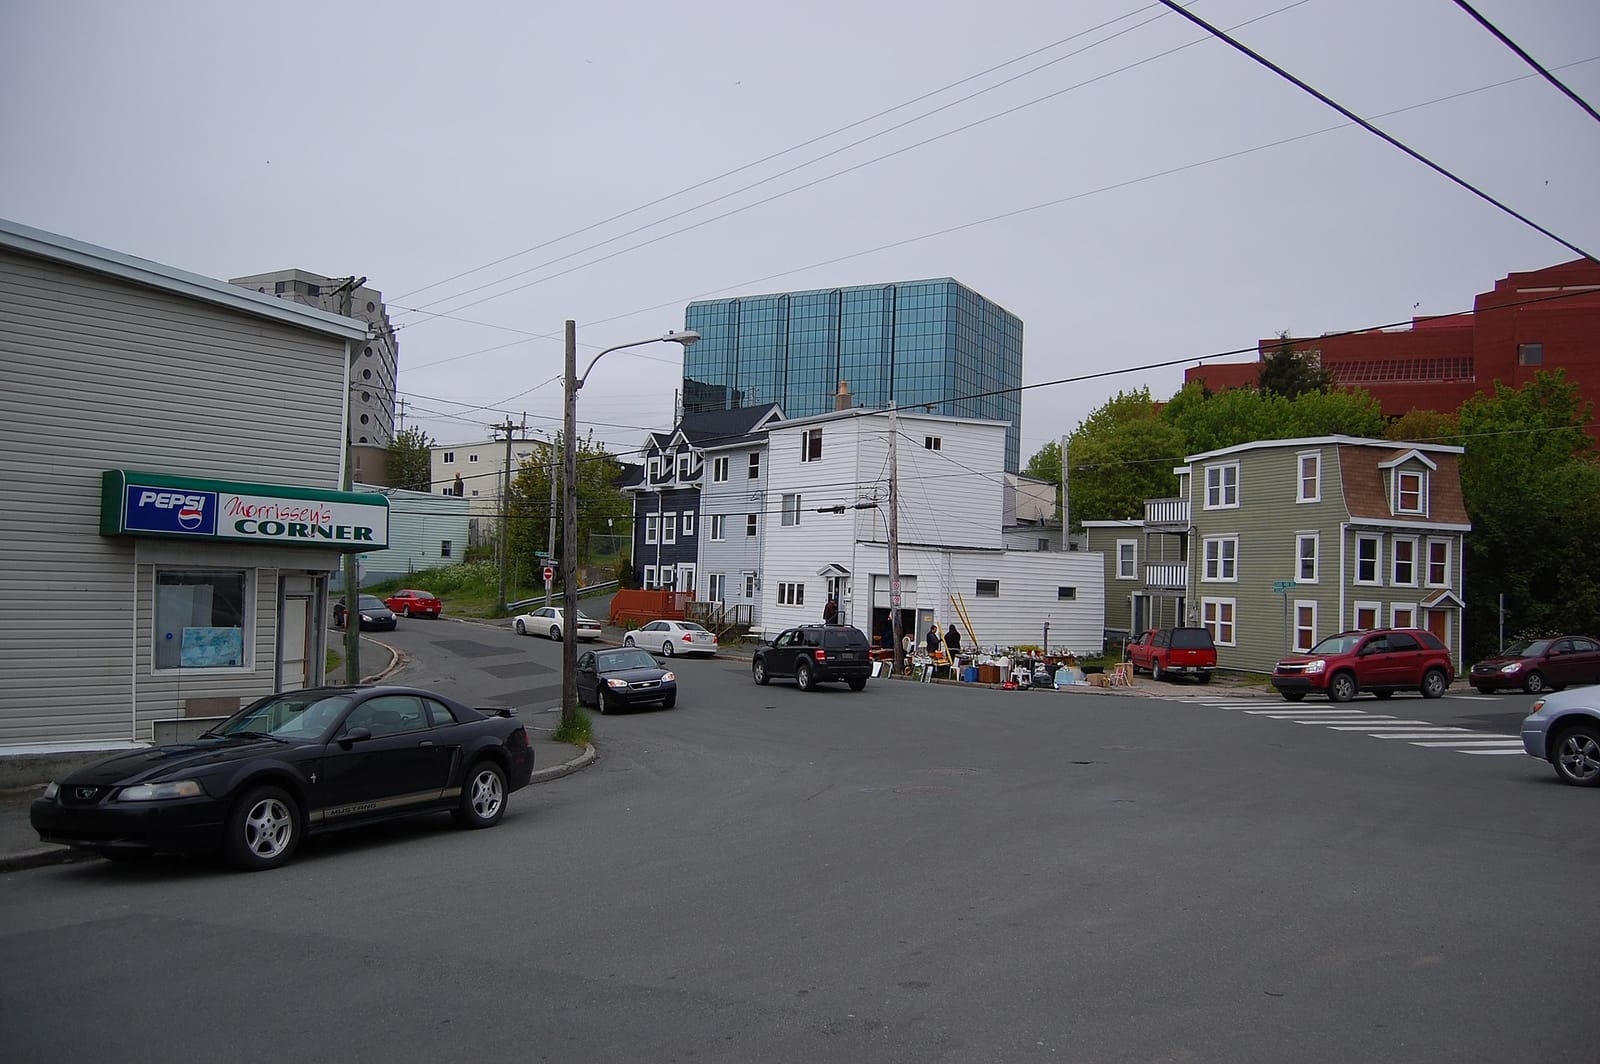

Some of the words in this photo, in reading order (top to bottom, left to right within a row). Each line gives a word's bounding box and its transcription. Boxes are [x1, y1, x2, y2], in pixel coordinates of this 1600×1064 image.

[138, 491, 206, 511] PEPSI
[224, 496, 331, 537] Morrissey's
[234, 519, 373, 541] CORNER
[331, 802, 377, 816] MUSTANG
